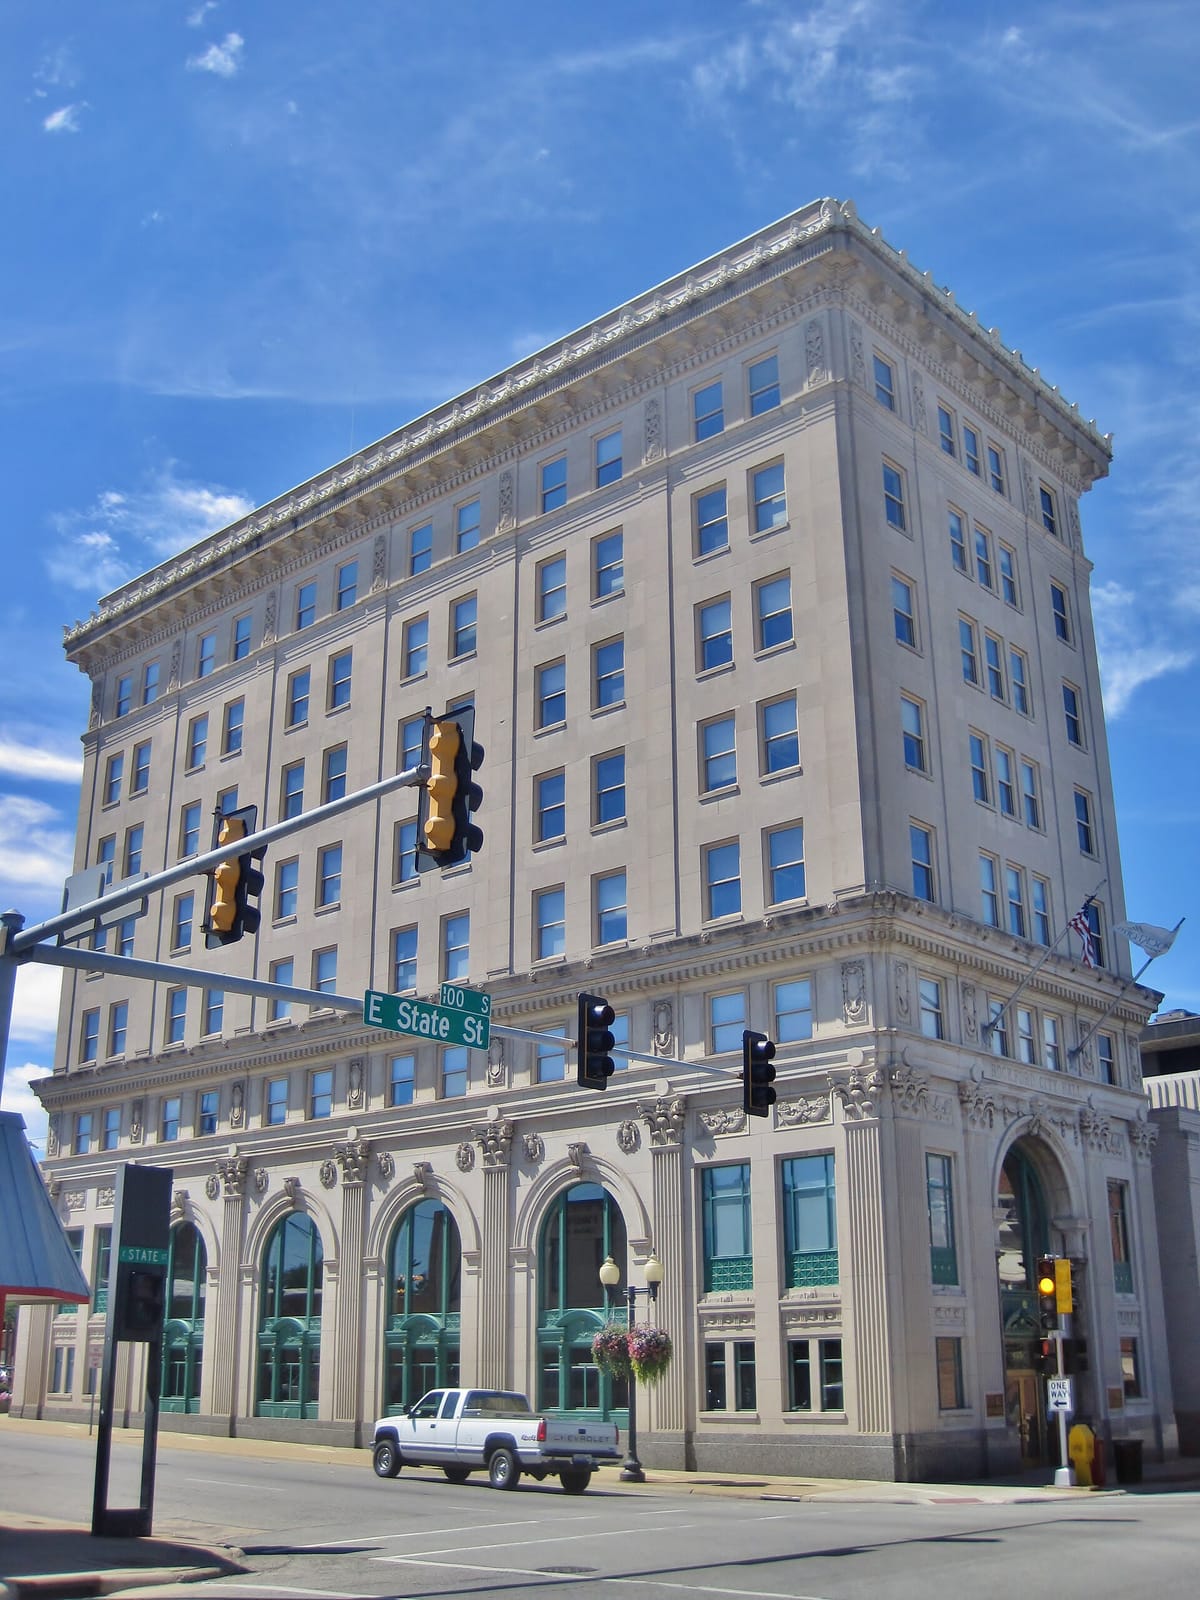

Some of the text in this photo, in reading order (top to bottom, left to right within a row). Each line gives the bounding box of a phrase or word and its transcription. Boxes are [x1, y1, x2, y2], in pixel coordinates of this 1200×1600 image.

[442, 986, 489, 1013] 100 S
[368, 994, 484, 1045] E State St
[128, 1249, 159, 1262] STATE
